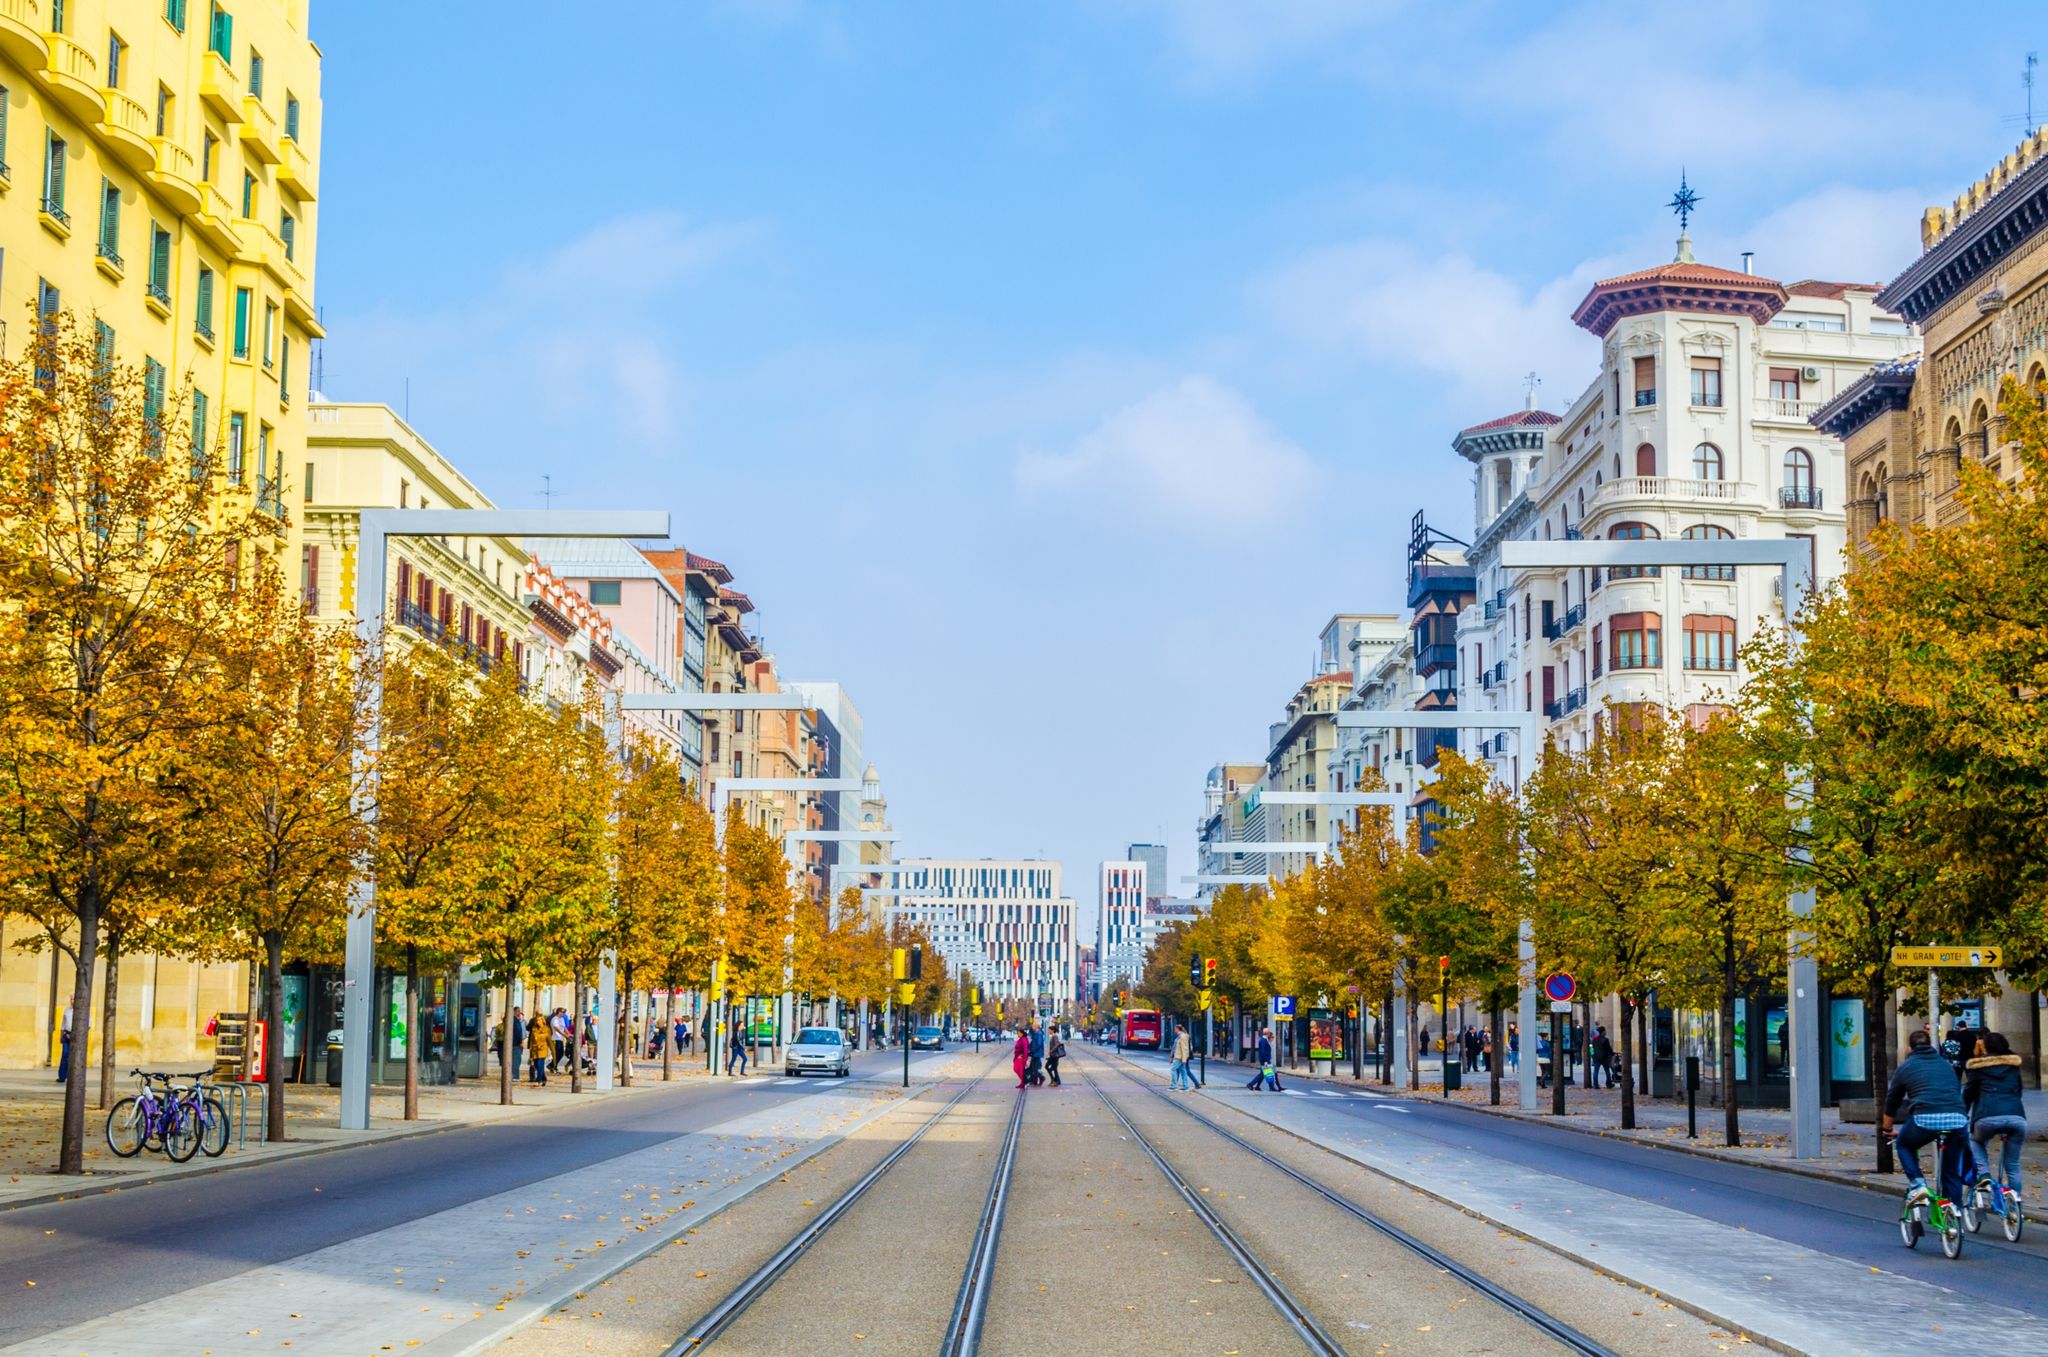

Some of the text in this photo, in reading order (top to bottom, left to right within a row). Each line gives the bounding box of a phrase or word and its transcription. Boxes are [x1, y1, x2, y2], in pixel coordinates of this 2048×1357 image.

[1896, 952, 1908, 960] NH
[1913, 952, 1934, 960] GRAN
[1278, 996, 1290, 1013] P
